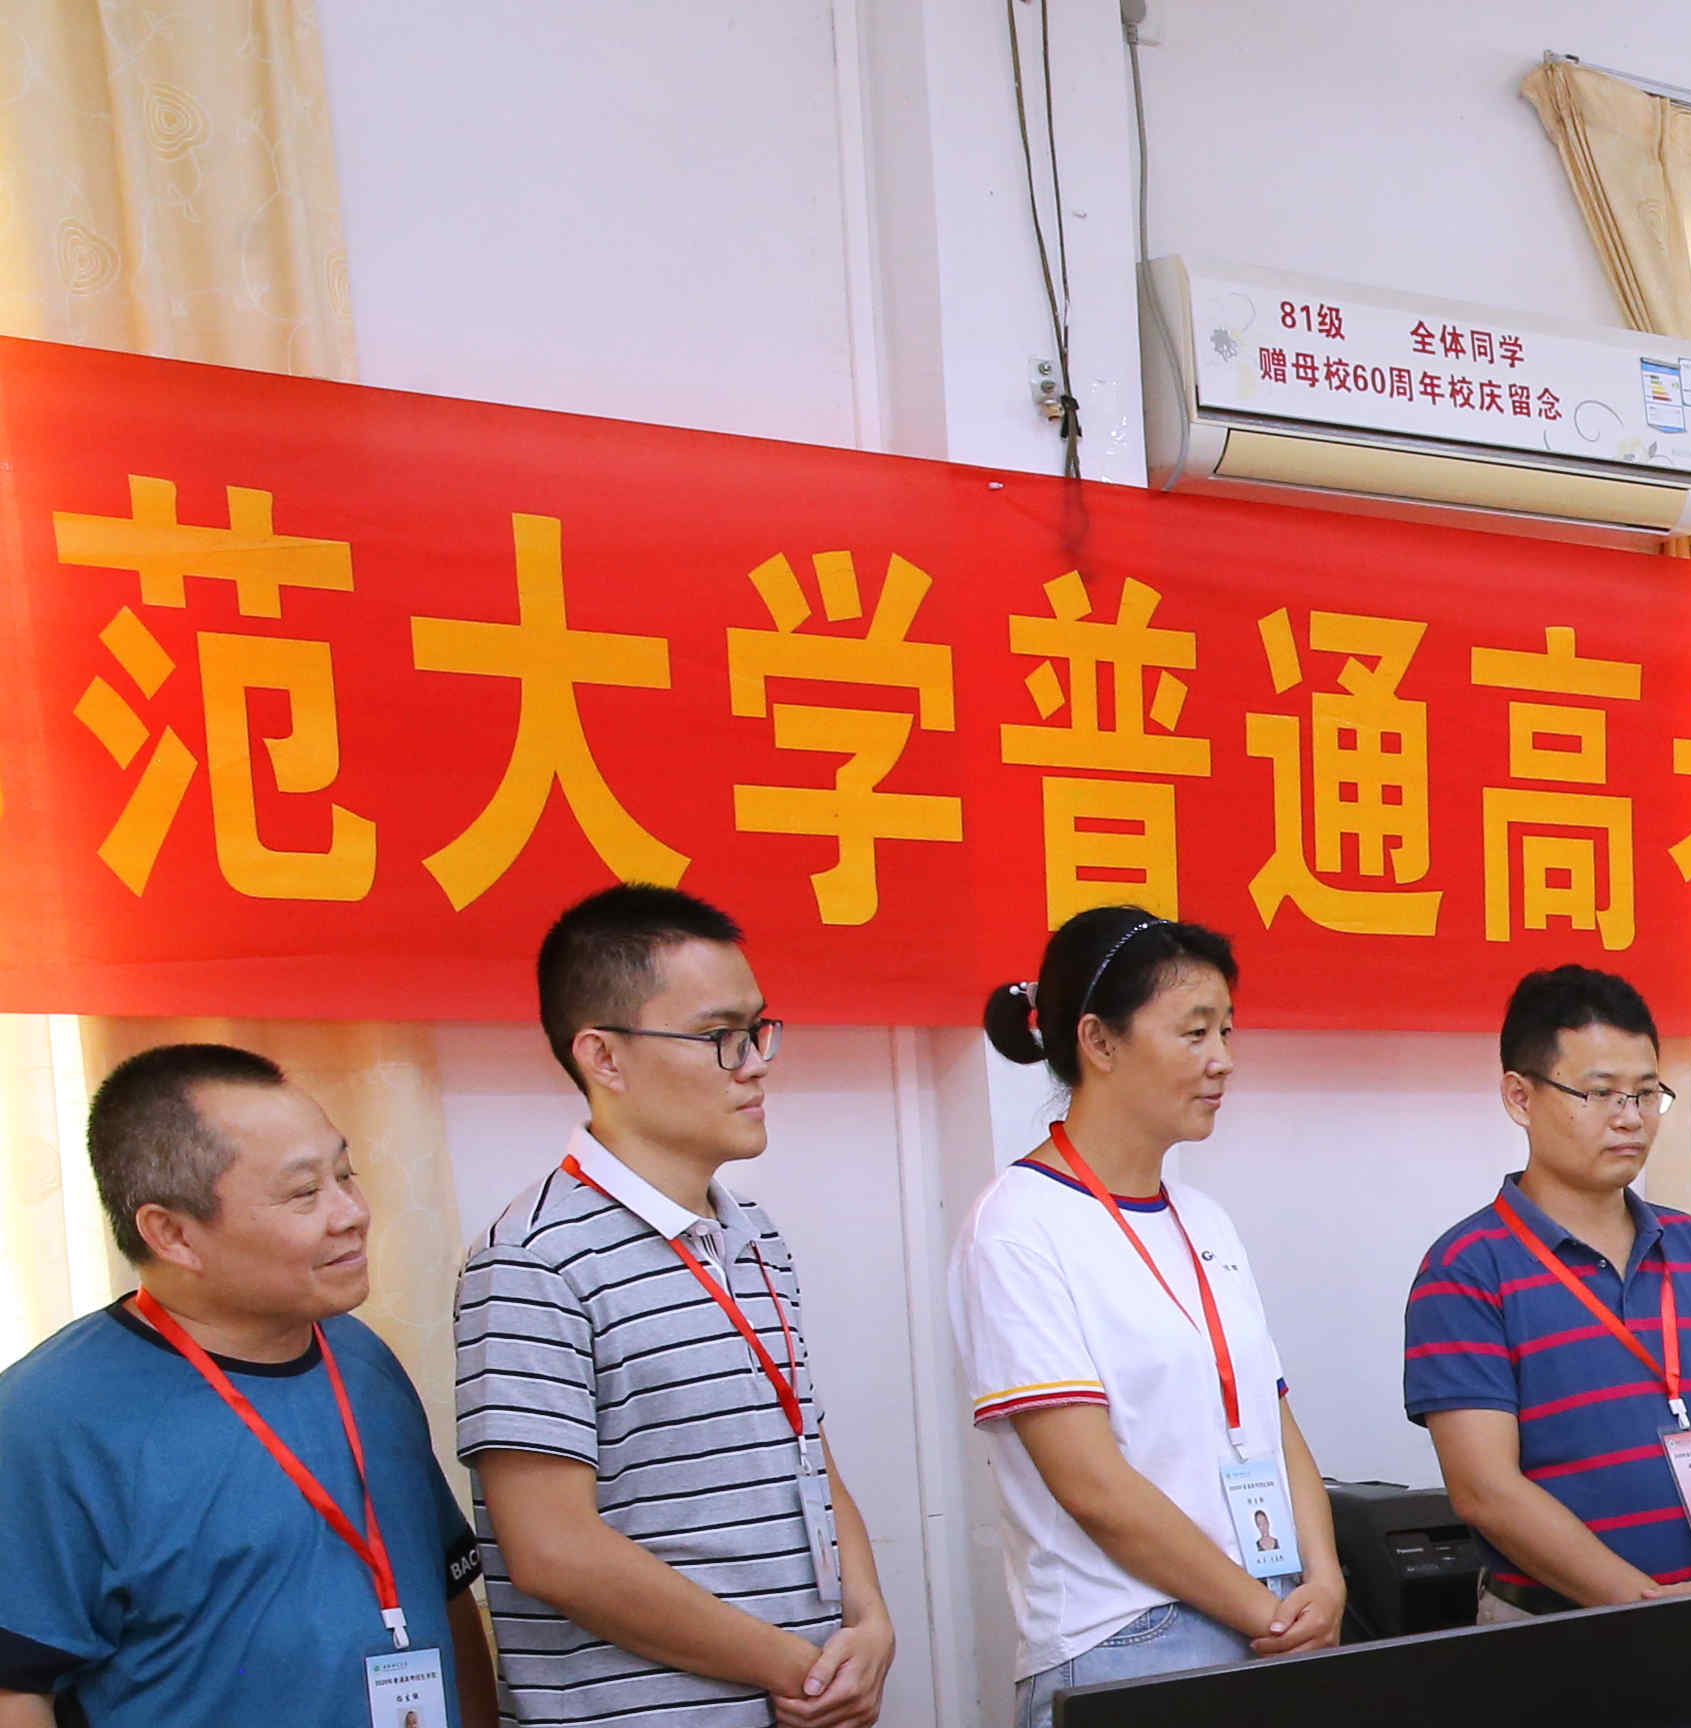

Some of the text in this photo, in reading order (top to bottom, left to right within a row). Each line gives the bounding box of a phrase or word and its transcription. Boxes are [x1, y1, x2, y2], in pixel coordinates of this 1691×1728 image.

[1280, 301, 1525, 369] 81级 全体同学
[1259, 346, 1563, 421] 赠母校60周年校庆留念
